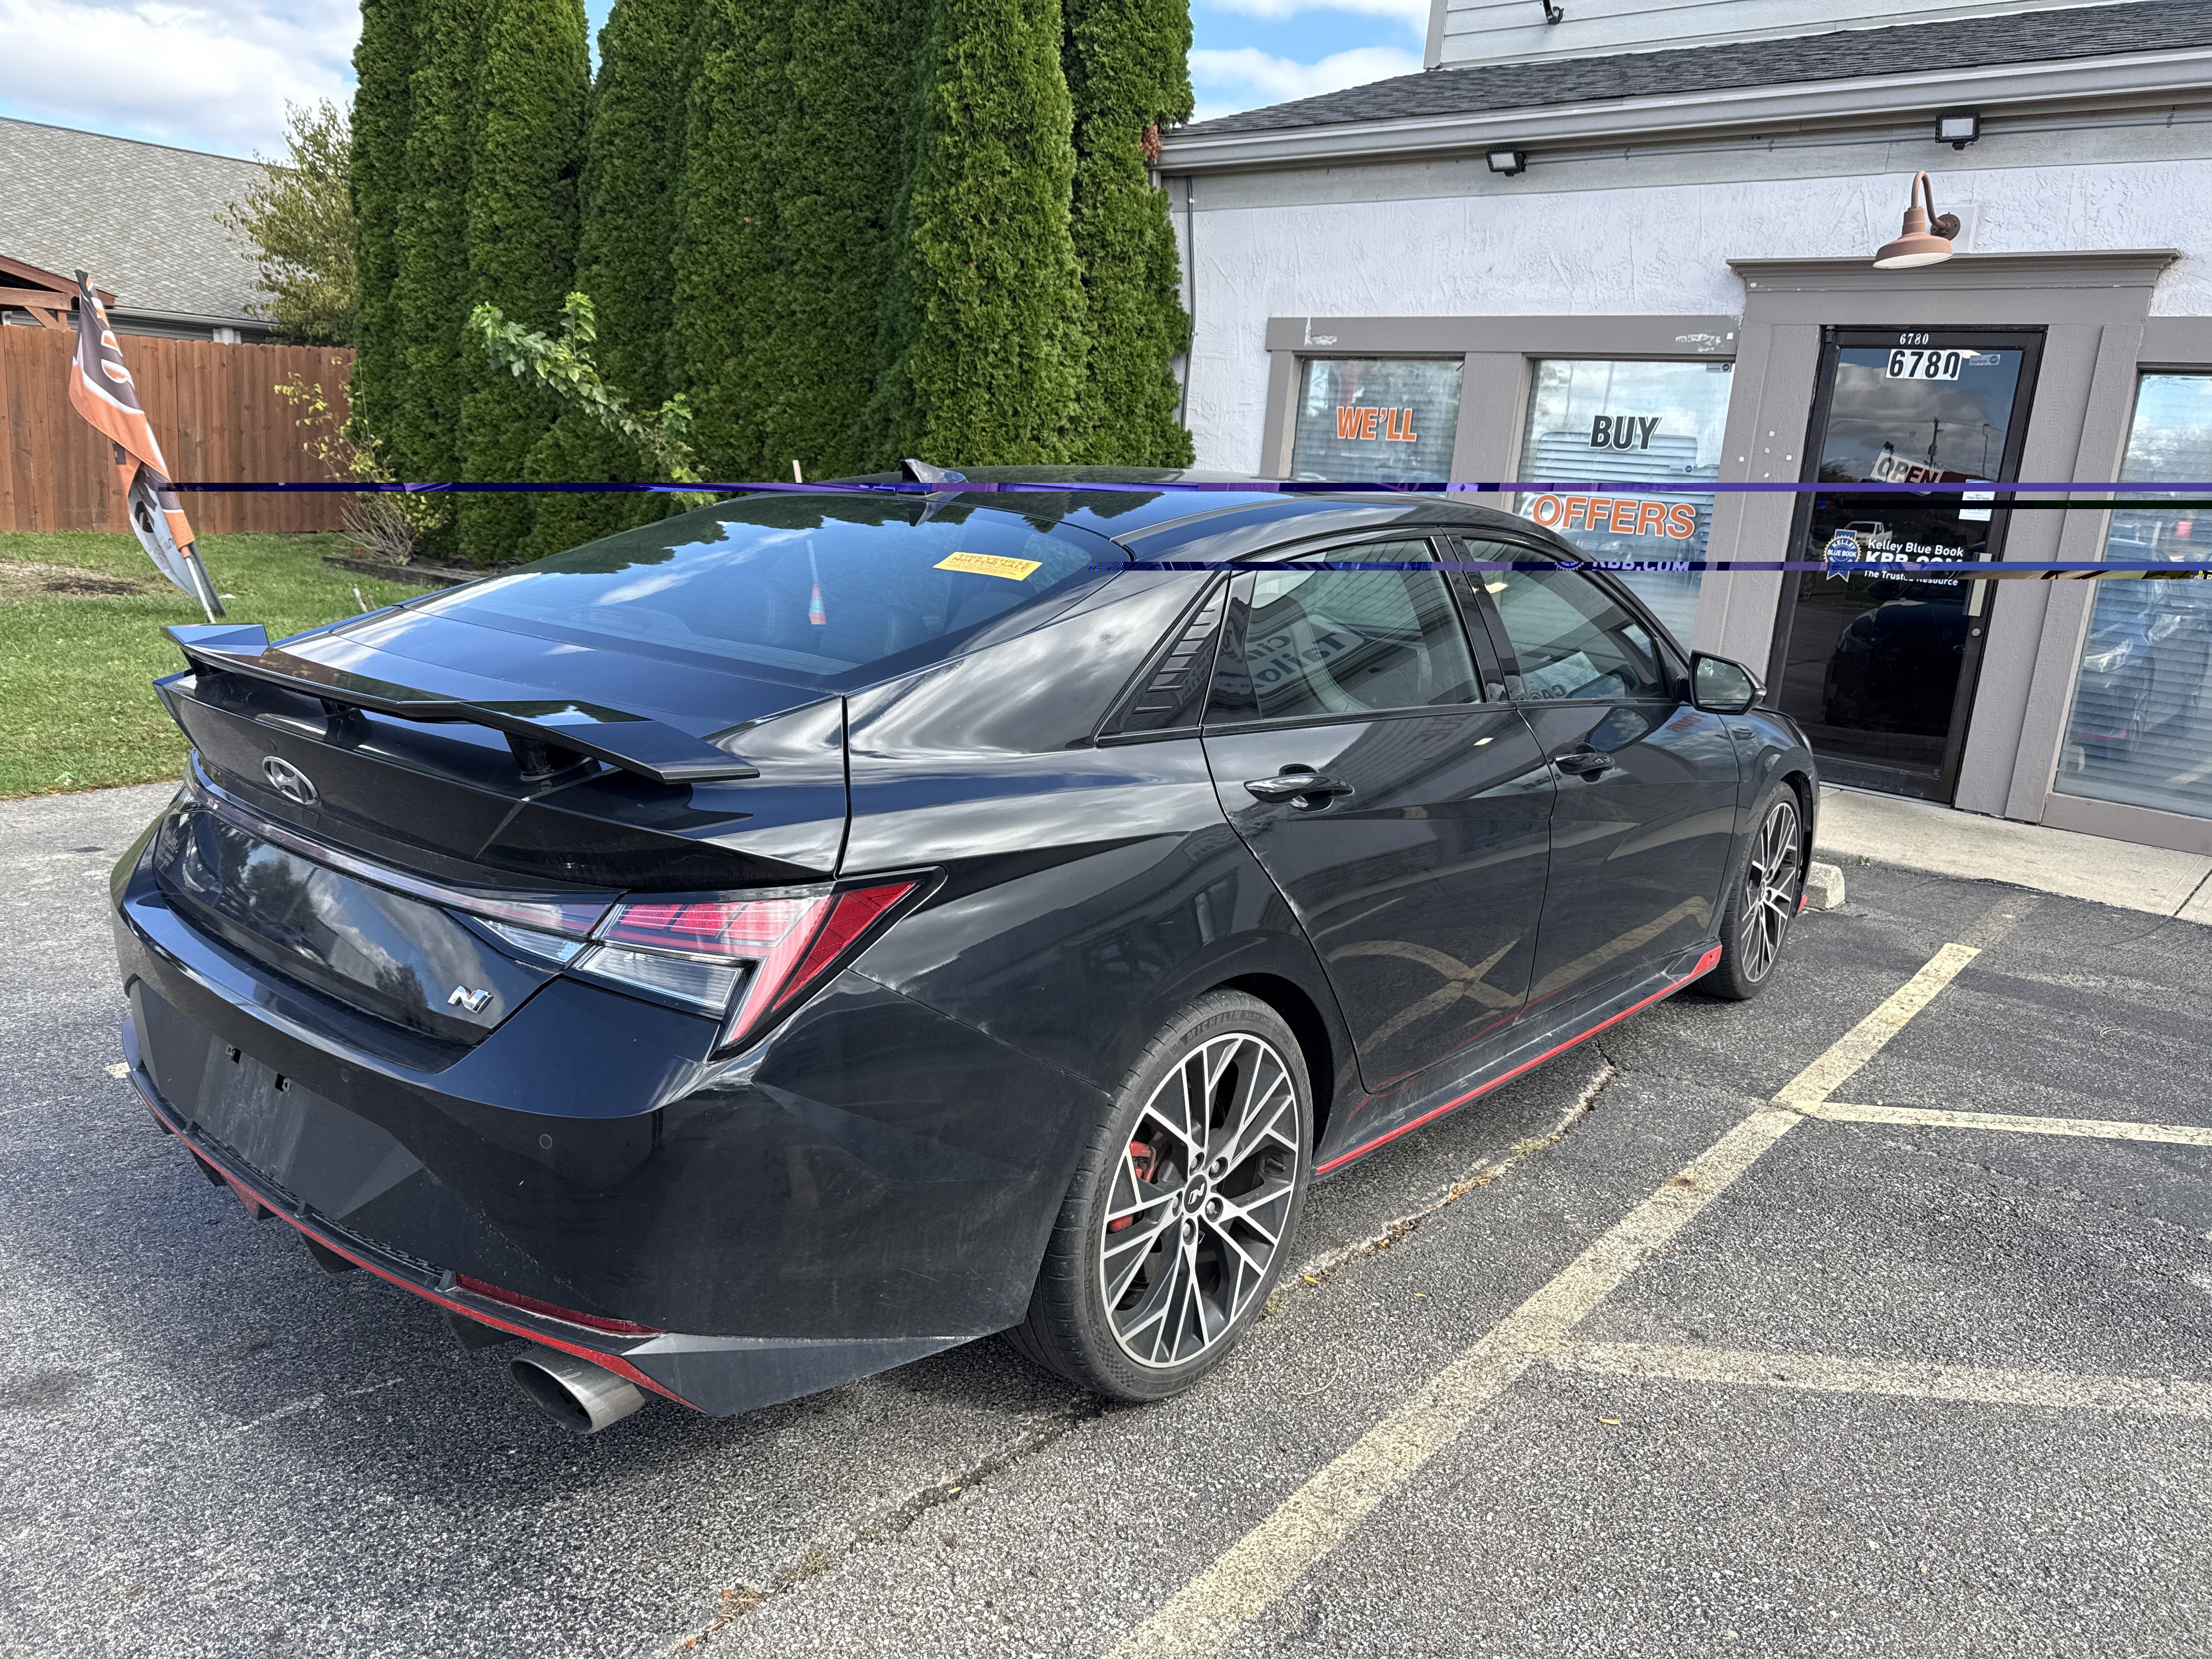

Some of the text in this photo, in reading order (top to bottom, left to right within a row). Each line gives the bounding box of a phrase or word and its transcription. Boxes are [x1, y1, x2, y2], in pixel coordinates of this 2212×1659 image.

[1899, 333, 1929, 345] 6780
[1889, 350, 1961, 379] 6780
[1336, 406, 1418, 442] WE'LL
[1589, 415, 1662, 451] BUY
[1877, 457, 1939, 484] OPEN
[1532, 493, 1696, 539] OFFERS
[1831, 539, 1857, 550] KELLEY
[1867, 539, 1964, 557] Kelley Blue Book
[987, 556, 1032, 567] VEHICLE
[1000, 562, 1028, 571] SALE
[1881, 571, 1914, 582] Trust
[1916, 577, 1959, 586] esource
[1187, 1011, 1241, 1041] MICHELIN
